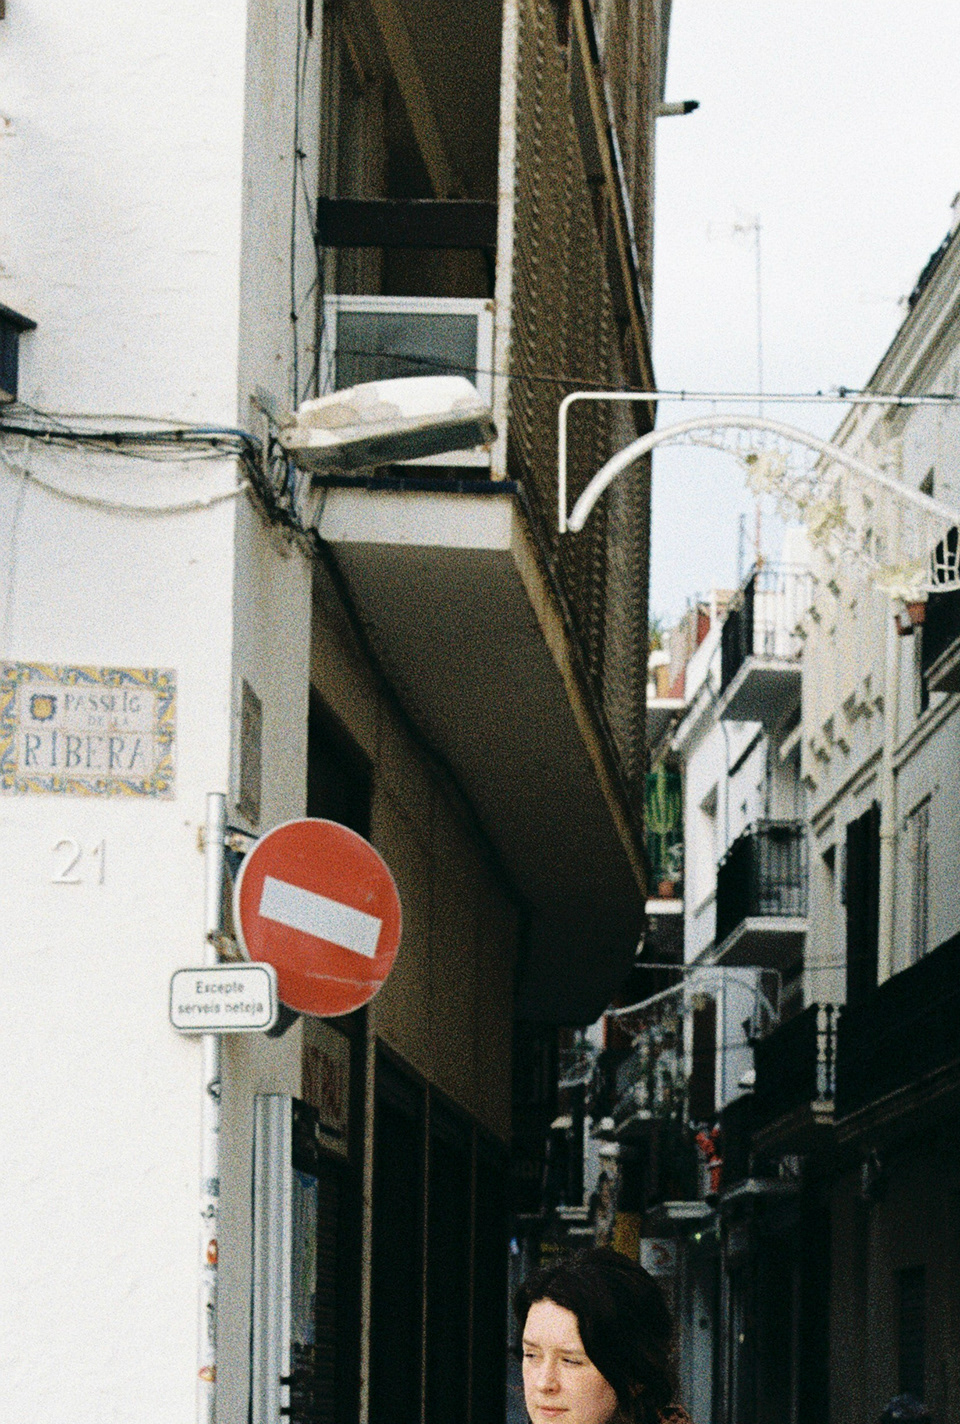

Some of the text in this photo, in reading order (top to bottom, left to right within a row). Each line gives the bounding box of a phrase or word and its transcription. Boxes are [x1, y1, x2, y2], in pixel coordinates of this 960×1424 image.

[64, 691, 141, 713] PASSEIG
[24, 730, 142, 769] RIBERA
[52, 839, 105, 885] 21
[195, 981, 245, 995] Excepte
[178, 1000, 264, 1016] serveis neteja
